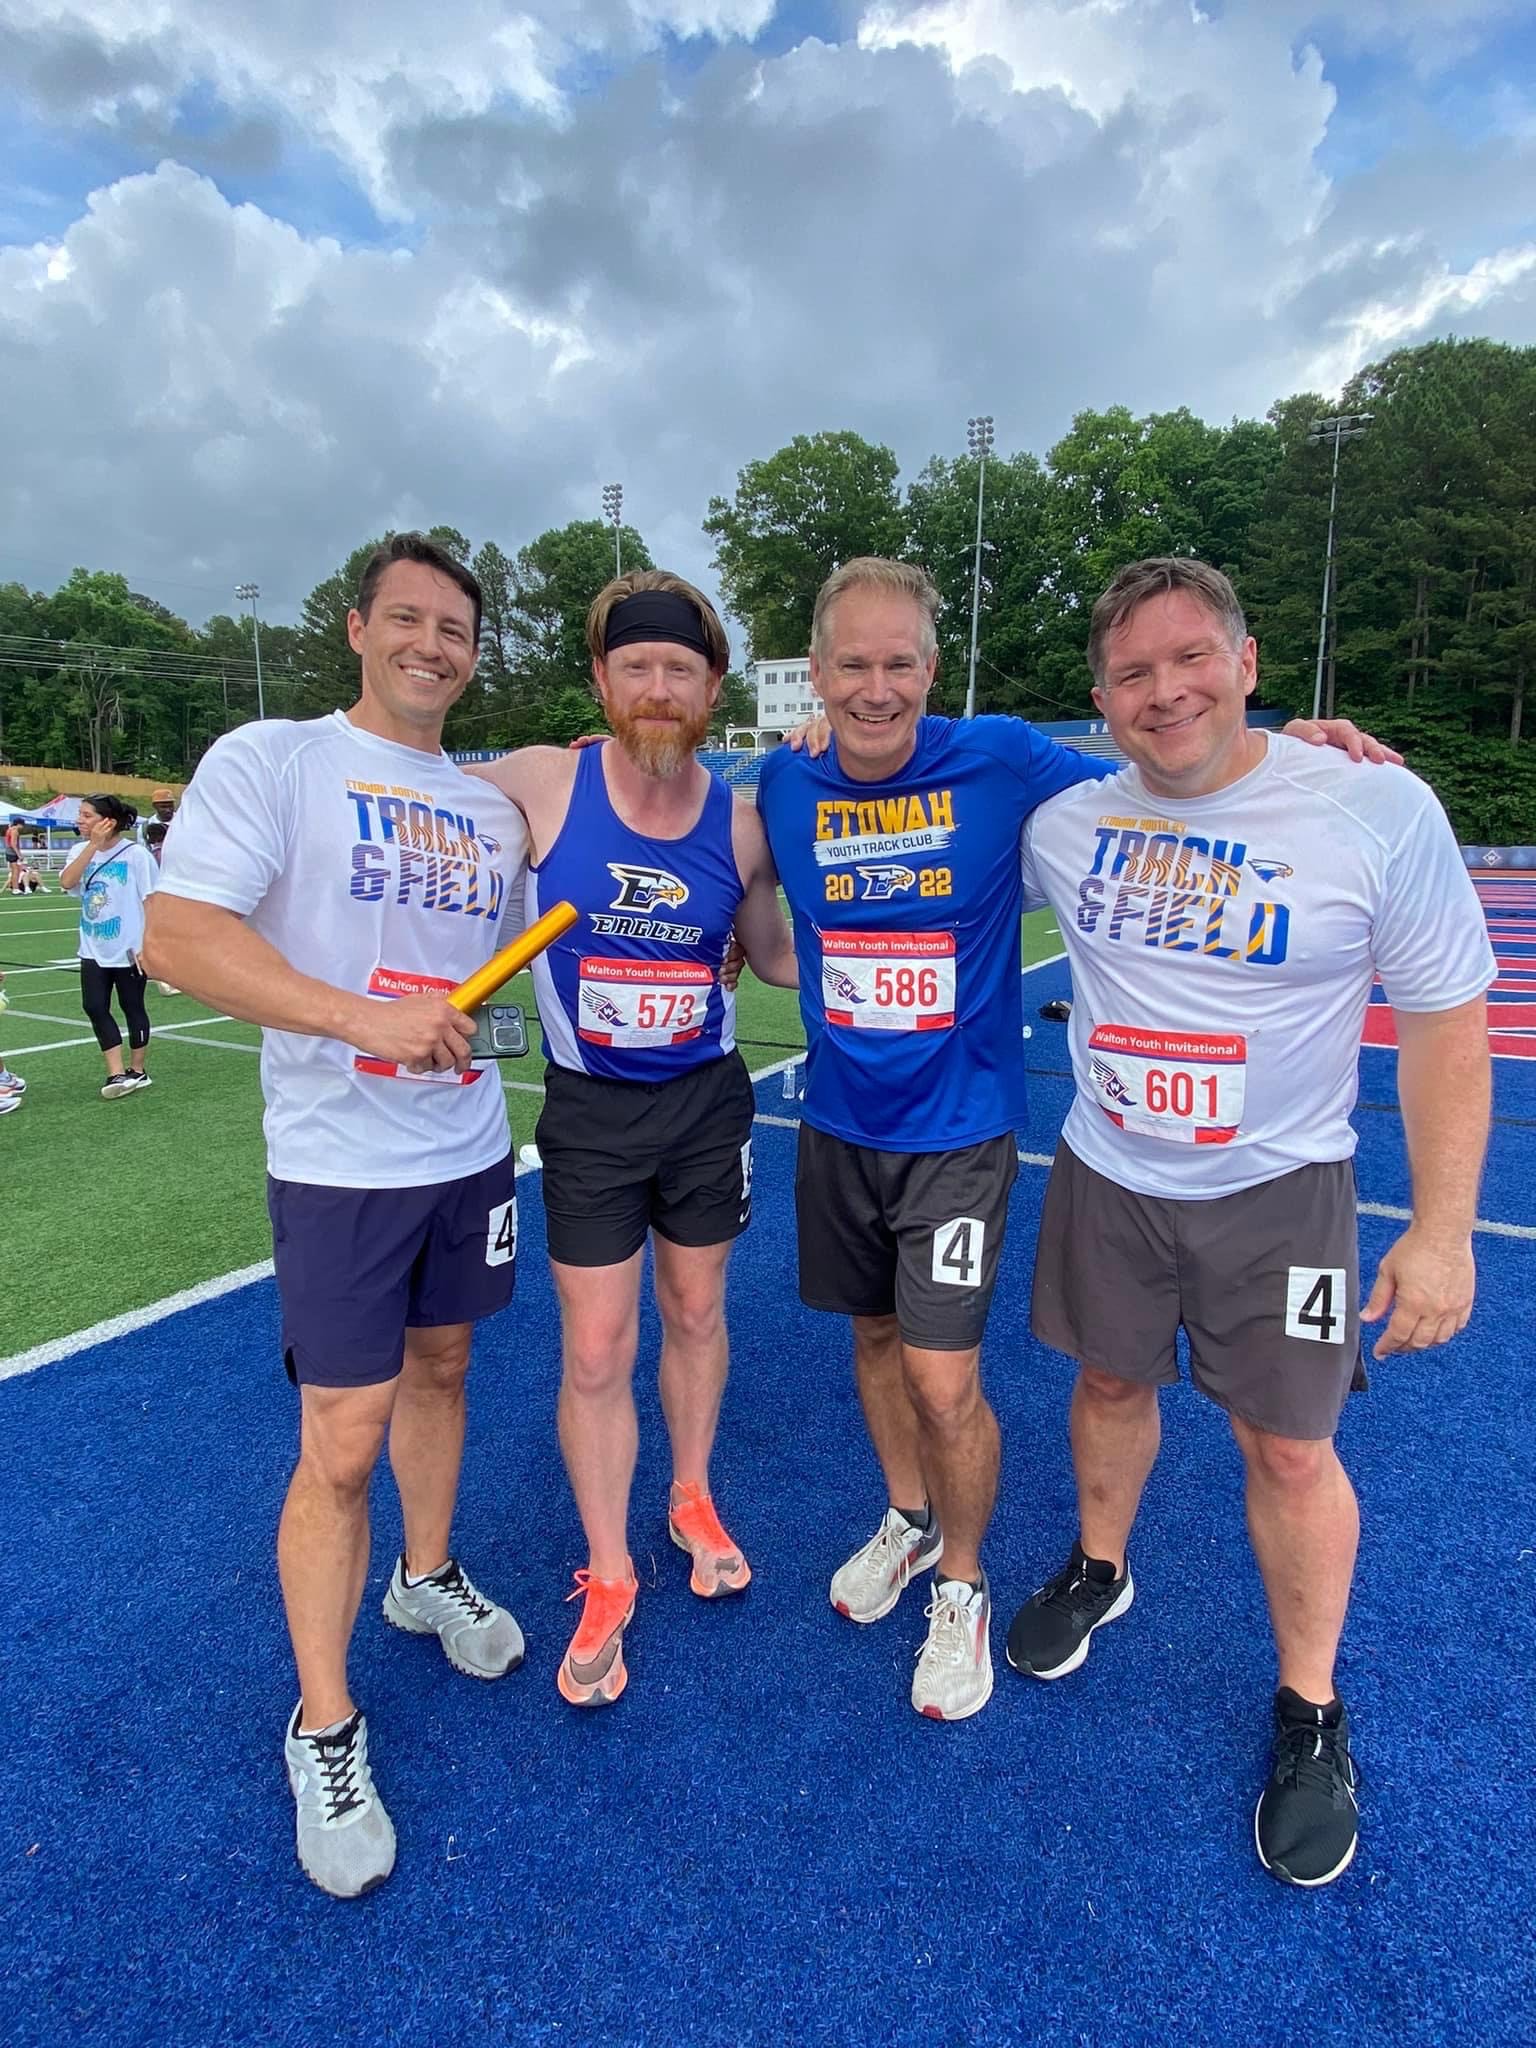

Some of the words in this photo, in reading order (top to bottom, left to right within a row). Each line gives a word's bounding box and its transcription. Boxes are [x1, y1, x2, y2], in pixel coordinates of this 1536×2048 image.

[347, 791, 480, 864] TRACK
[816, 790, 955, 841] ETOWAH
[827, 847, 861, 858] YOUTH
[862, 841, 900, 855] TRACK
[903, 833, 933, 848] CLUB
[1089, 828, 1247, 896] TRACK
[350, 843, 391, 902] &
[397, 850, 504, 921] FIELD
[826, 874, 854, 901] 20
[919, 867, 952, 897] 22
[588, 913, 703, 945] EAGLES
[1077, 878, 1106, 933] &
[1108, 885, 1290, 965] FIELD
[823, 939, 857, 950] Walton
[859, 940, 888, 951] Youth
[891, 939, 949, 951] Invitational
[378, 976, 419, 993] Walton
[586, 964, 622, 976] Walton
[625, 967, 654, 977] Youth
[656, 969, 707, 979] Invitational
[875, 967, 938, 1007] 586
[637, 994, 696, 1029] 573
[1096, 1032, 1127, 1046] Walton
[1130, 1037, 1161, 1050] Youth
[1165, 1040, 1238, 1055] Invitational
[1145, 1068, 1218, 1118] 601
[495, 1204, 514, 1257] 4
[942, 1222, 974, 1281] 4
[1298, 1274, 1337, 1340] 4
